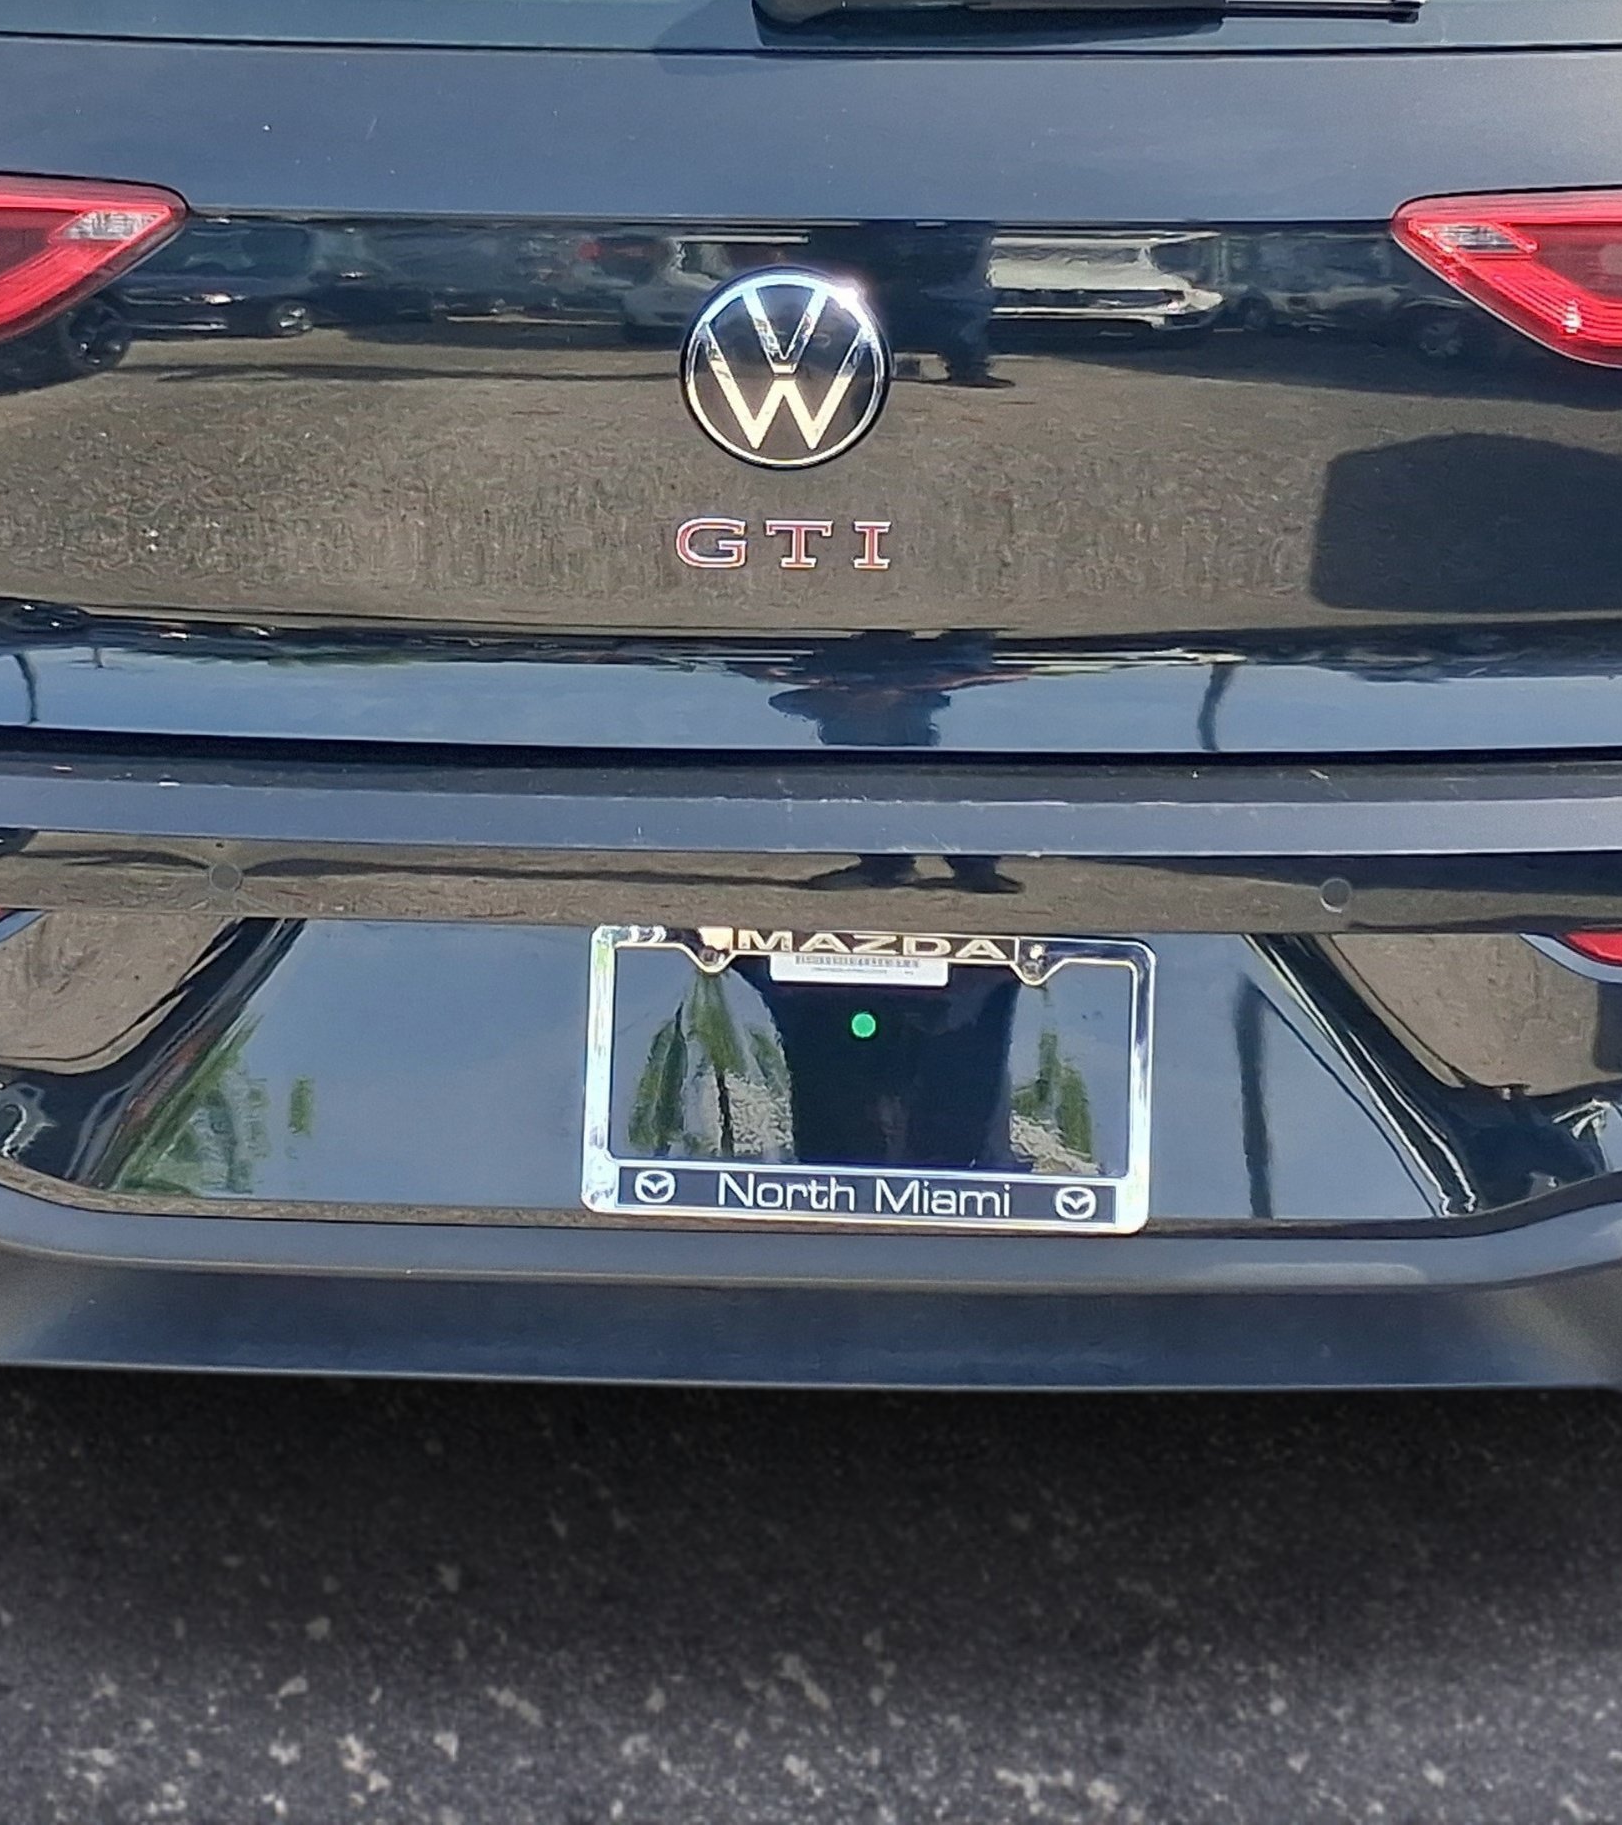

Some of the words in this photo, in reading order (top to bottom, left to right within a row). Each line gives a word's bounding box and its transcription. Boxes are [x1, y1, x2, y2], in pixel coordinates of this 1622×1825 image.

[676, 516, 892, 571] GTI
[738, 929, 1007, 960] MAZDA
[717, 1171, 856, 1211] North
[875, 1177, 1012, 1217] Miami
